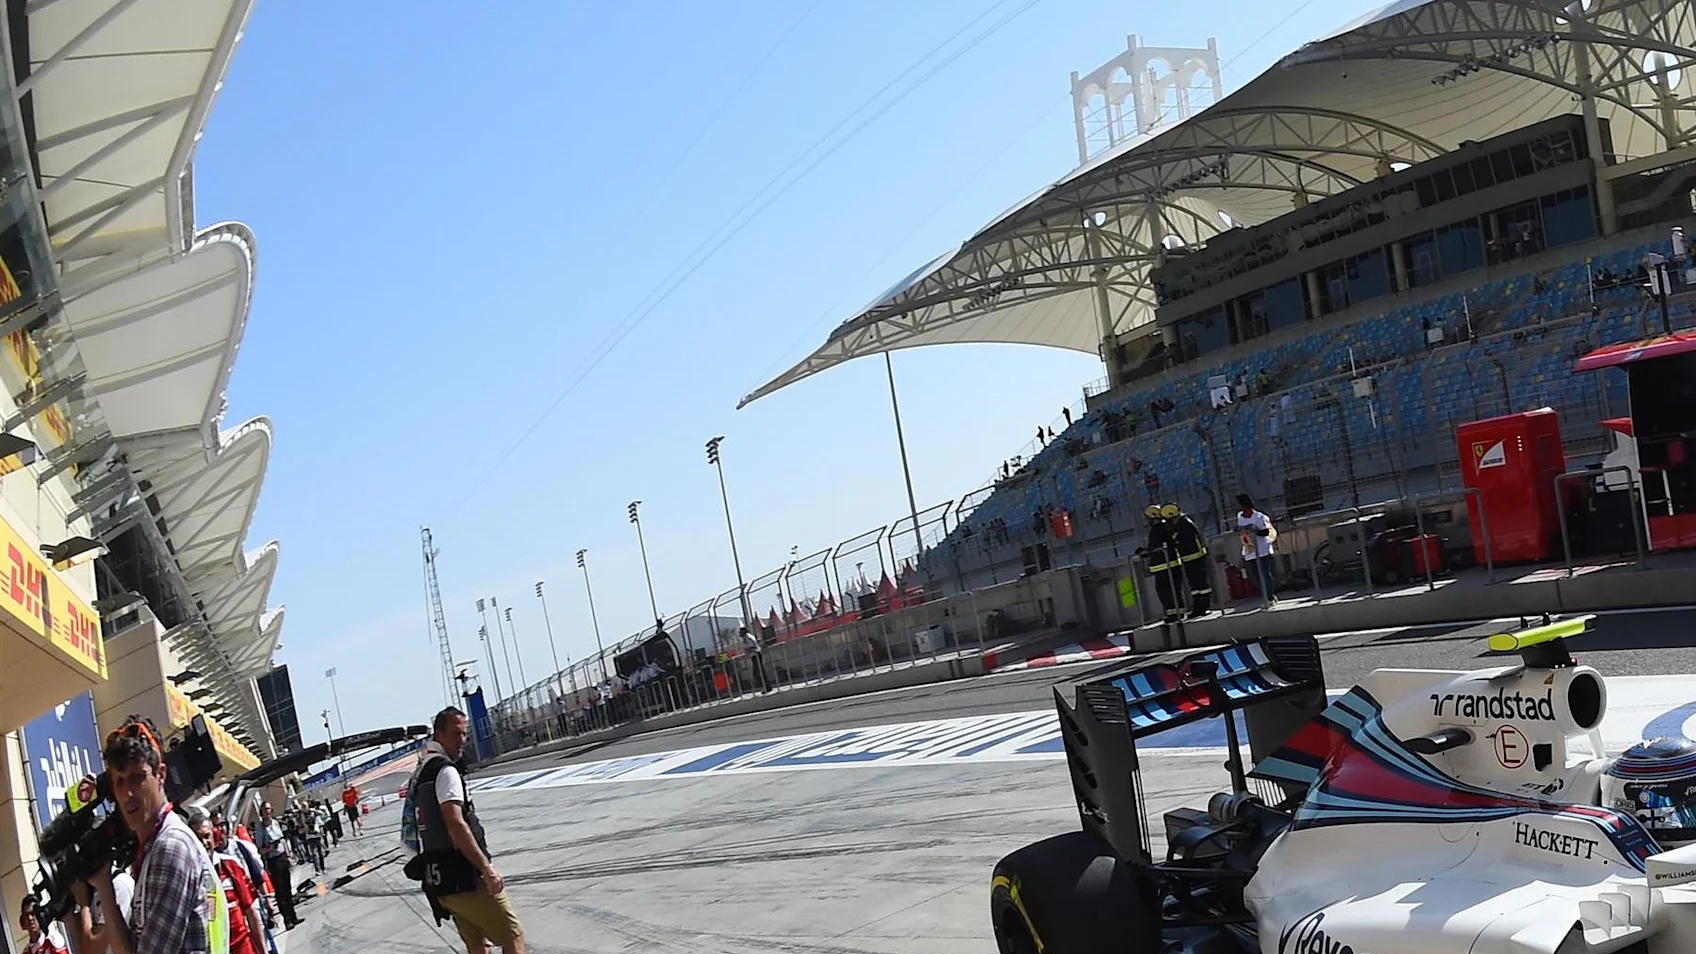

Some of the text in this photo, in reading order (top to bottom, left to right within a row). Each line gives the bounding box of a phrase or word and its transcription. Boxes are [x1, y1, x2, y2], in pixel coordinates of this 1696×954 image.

[8, 541, 52, 629] DHL
[67, 600, 101, 664] DHL
[1455, 687, 1555, 721] randstad
[1501, 730, 1521, 764] E
[1515, 823, 1598, 859] HACKETT
